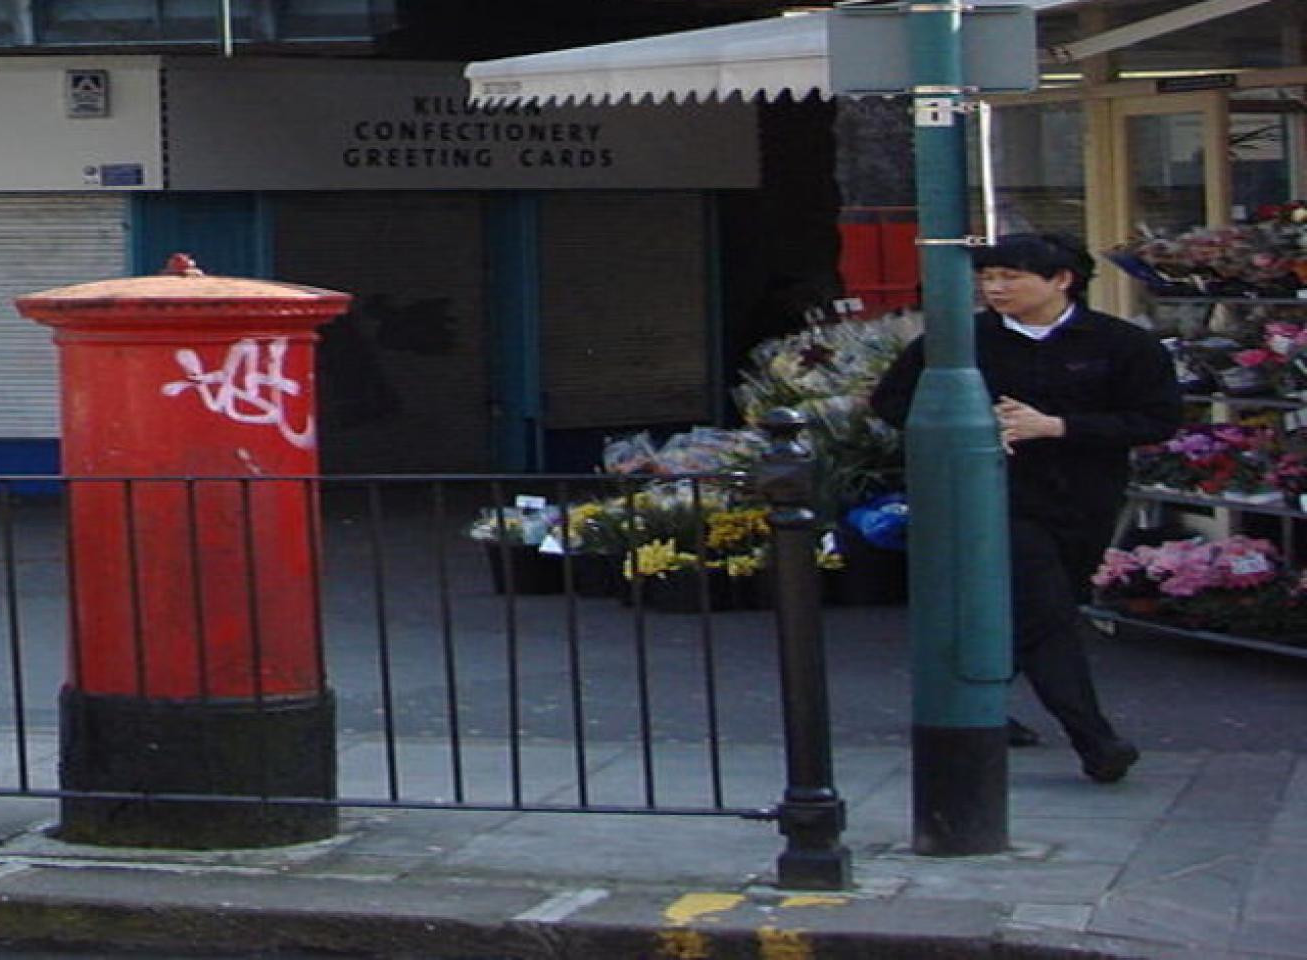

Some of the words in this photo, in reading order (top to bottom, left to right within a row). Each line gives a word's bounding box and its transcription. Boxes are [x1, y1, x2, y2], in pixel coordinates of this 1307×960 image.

[354, 121, 602, 142] CONFECTIONERY
[342, 147, 492, 169] GREETING
[518, 147, 614, 169] CARDS
